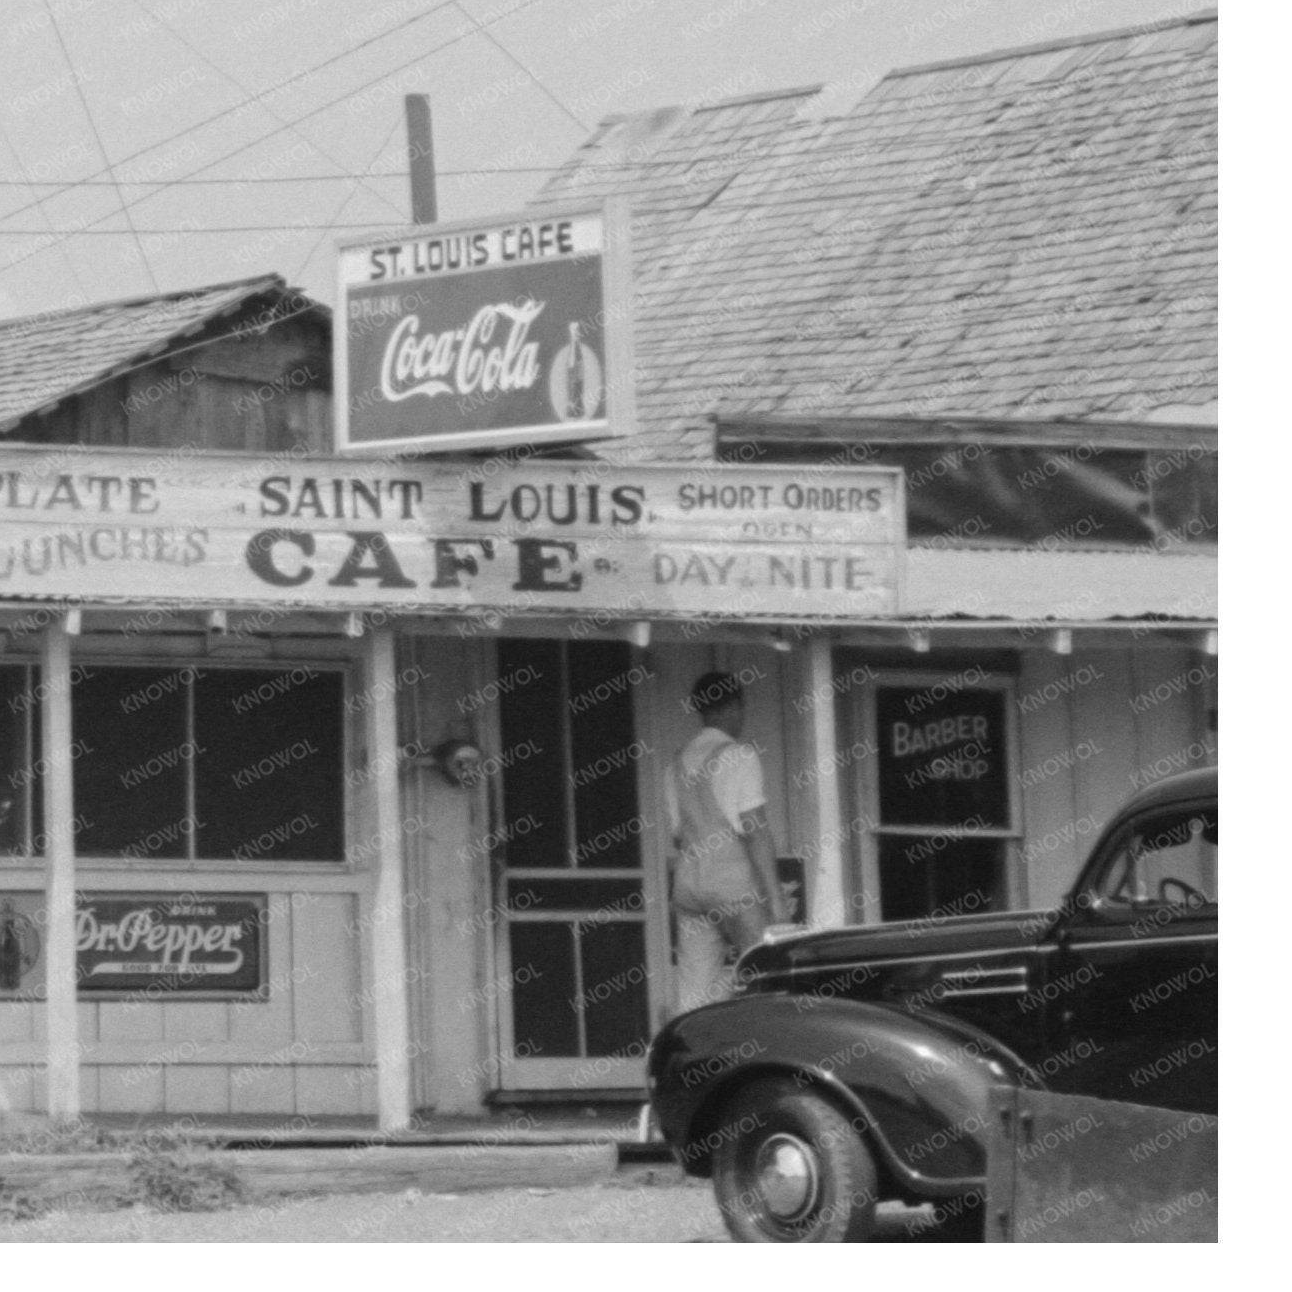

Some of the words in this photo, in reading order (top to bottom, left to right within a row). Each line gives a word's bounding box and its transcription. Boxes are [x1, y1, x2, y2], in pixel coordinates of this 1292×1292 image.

[369, 246, 406, 281] ST.
[413, 232, 490, 274] LOUIS
[500, 220, 574, 261] CAFE
[349, 294, 402, 319] DRINK
[380, 298, 547, 402] Coca-Cola
[259, 475, 424, 521] SAINT
[467, 480, 647, 527] LOUIS
[677, 482, 773, 511] SHORT
[782, 482, 883, 512] ORDERS
[245, 527, 584, 592] CAFE
[652, 552, 737, 587] DAY
[768, 554, 875, 592] NITE
[892, 714, 989, 758] BARBER
